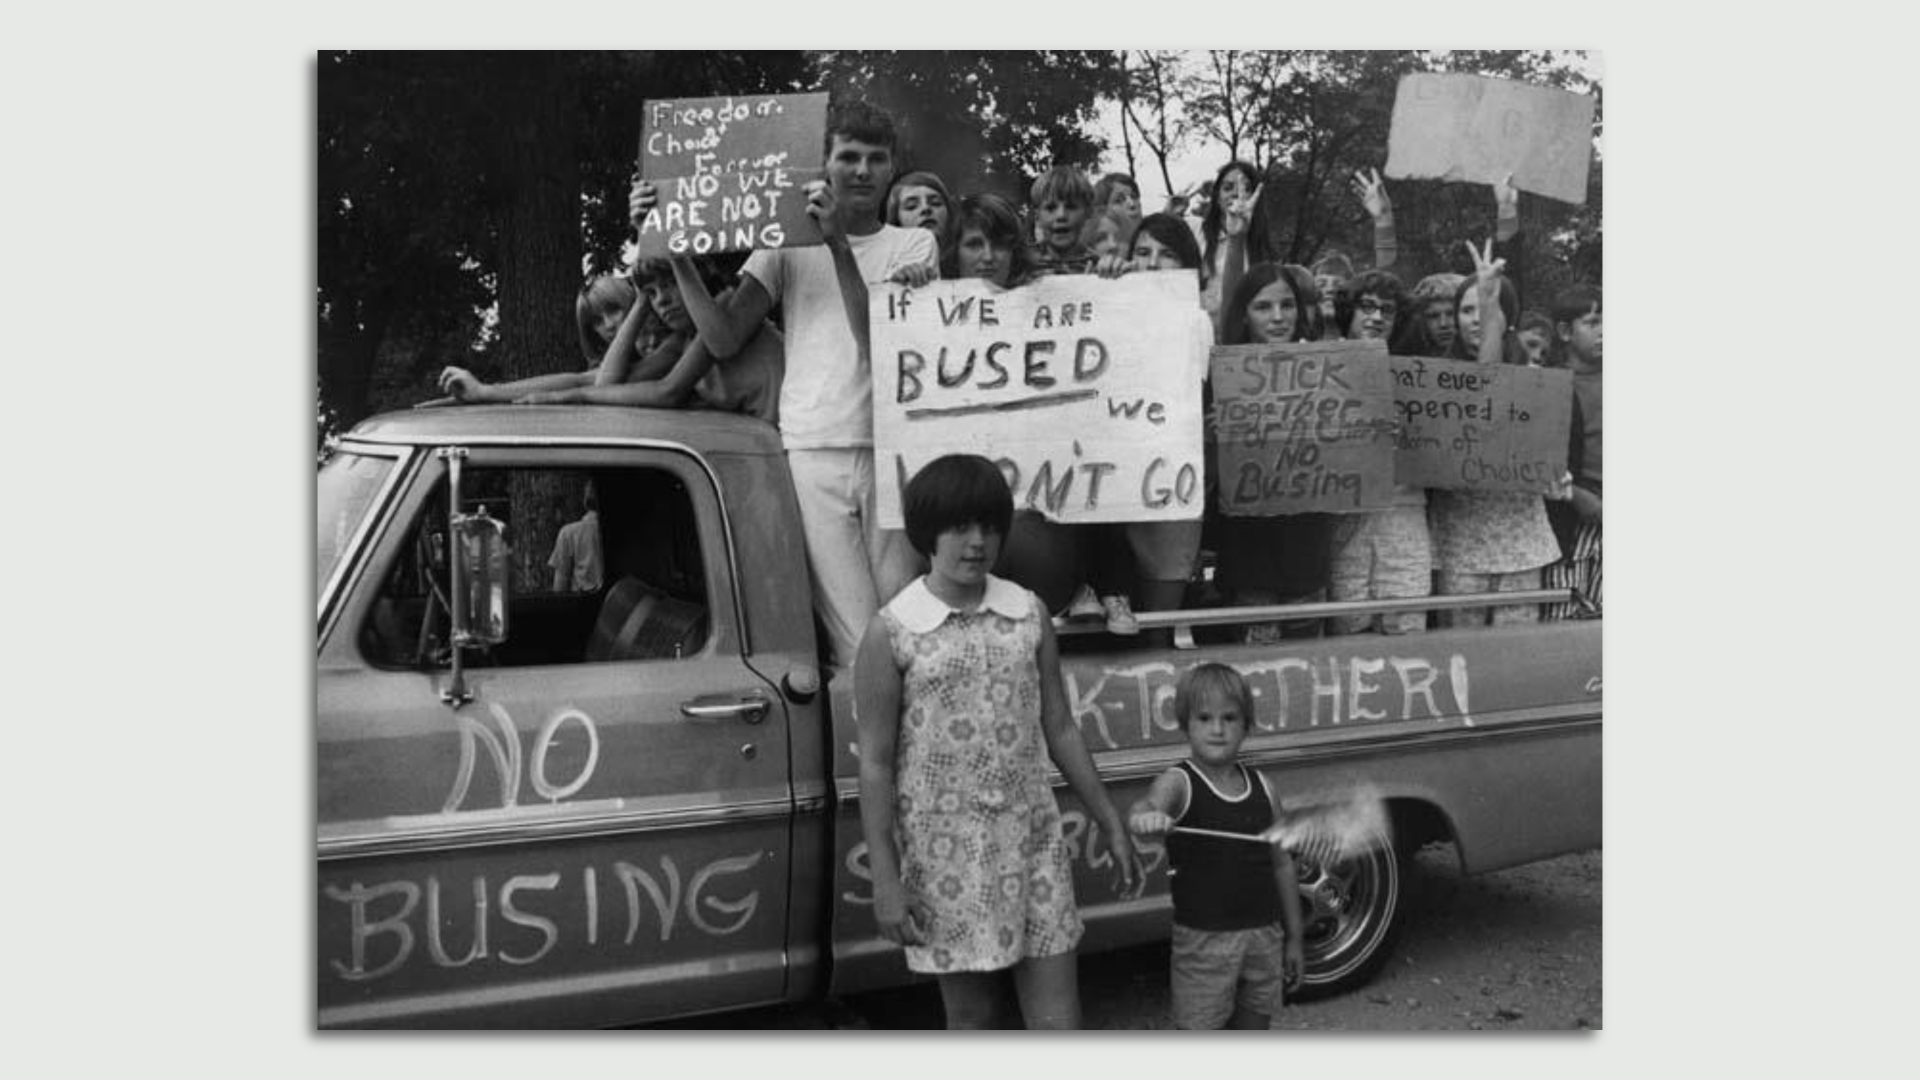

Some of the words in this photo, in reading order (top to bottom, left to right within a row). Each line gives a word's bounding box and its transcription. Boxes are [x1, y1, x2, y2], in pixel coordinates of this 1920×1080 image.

[677, 174, 719, 200] NO
[739, 168, 793, 193] WE
[641, 201, 708, 234] ARE
[722, 190, 782, 222] NOT
[668, 222, 785, 253] GOING
[889, 287, 912, 321] If
[937, 296, 999, 328] WE
[1034, 302, 1093, 328] ARE
[897, 337, 1110, 404] BUSED
[1240, 355, 1352, 395] STICK
[1509, 402, 1530, 422] to
[1453, 424, 1479, 454] of
[1141, 457, 1197, 509] GO
[442, 702, 600, 814] NO
[325, 851, 763, 981] BUSING
